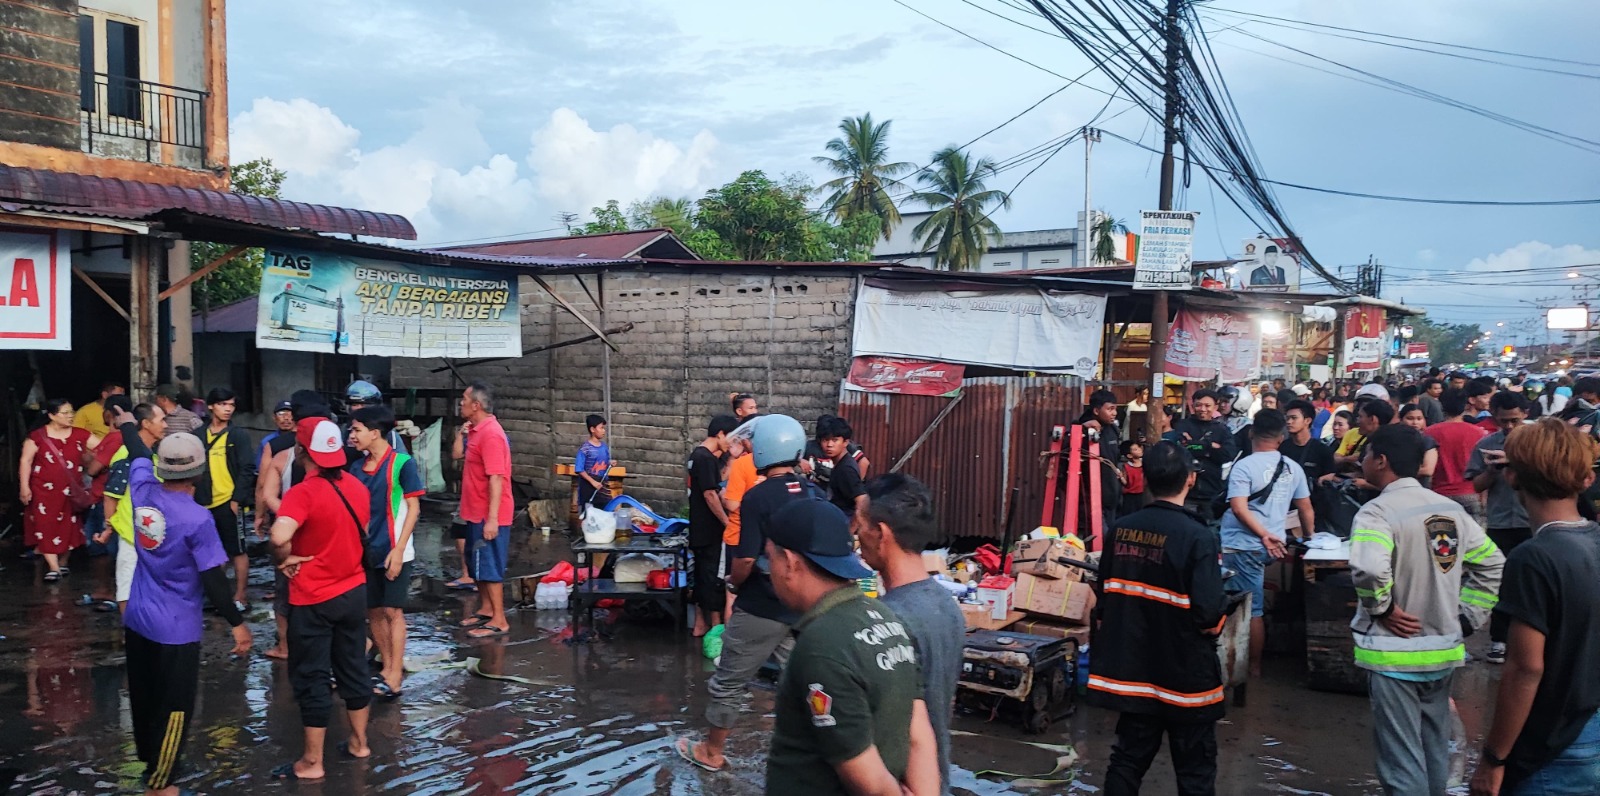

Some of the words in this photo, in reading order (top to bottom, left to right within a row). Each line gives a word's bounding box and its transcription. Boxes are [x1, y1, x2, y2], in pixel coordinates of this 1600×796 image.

[270, 251, 311, 271] TAG
[0, 258, 40, 308] A
[355, 267, 426, 286] BENGKEL
[428, 276, 446, 288] INI
[355, 282, 392, 298] AKI
[397, 286, 510, 304] BERGARANSI
[291, 301, 307, 310] TAG
[360, 297, 436, 318] TANPA
[441, 302, 506, 319] RIBET
[1115, 527, 1168, 548] PEMADAM
